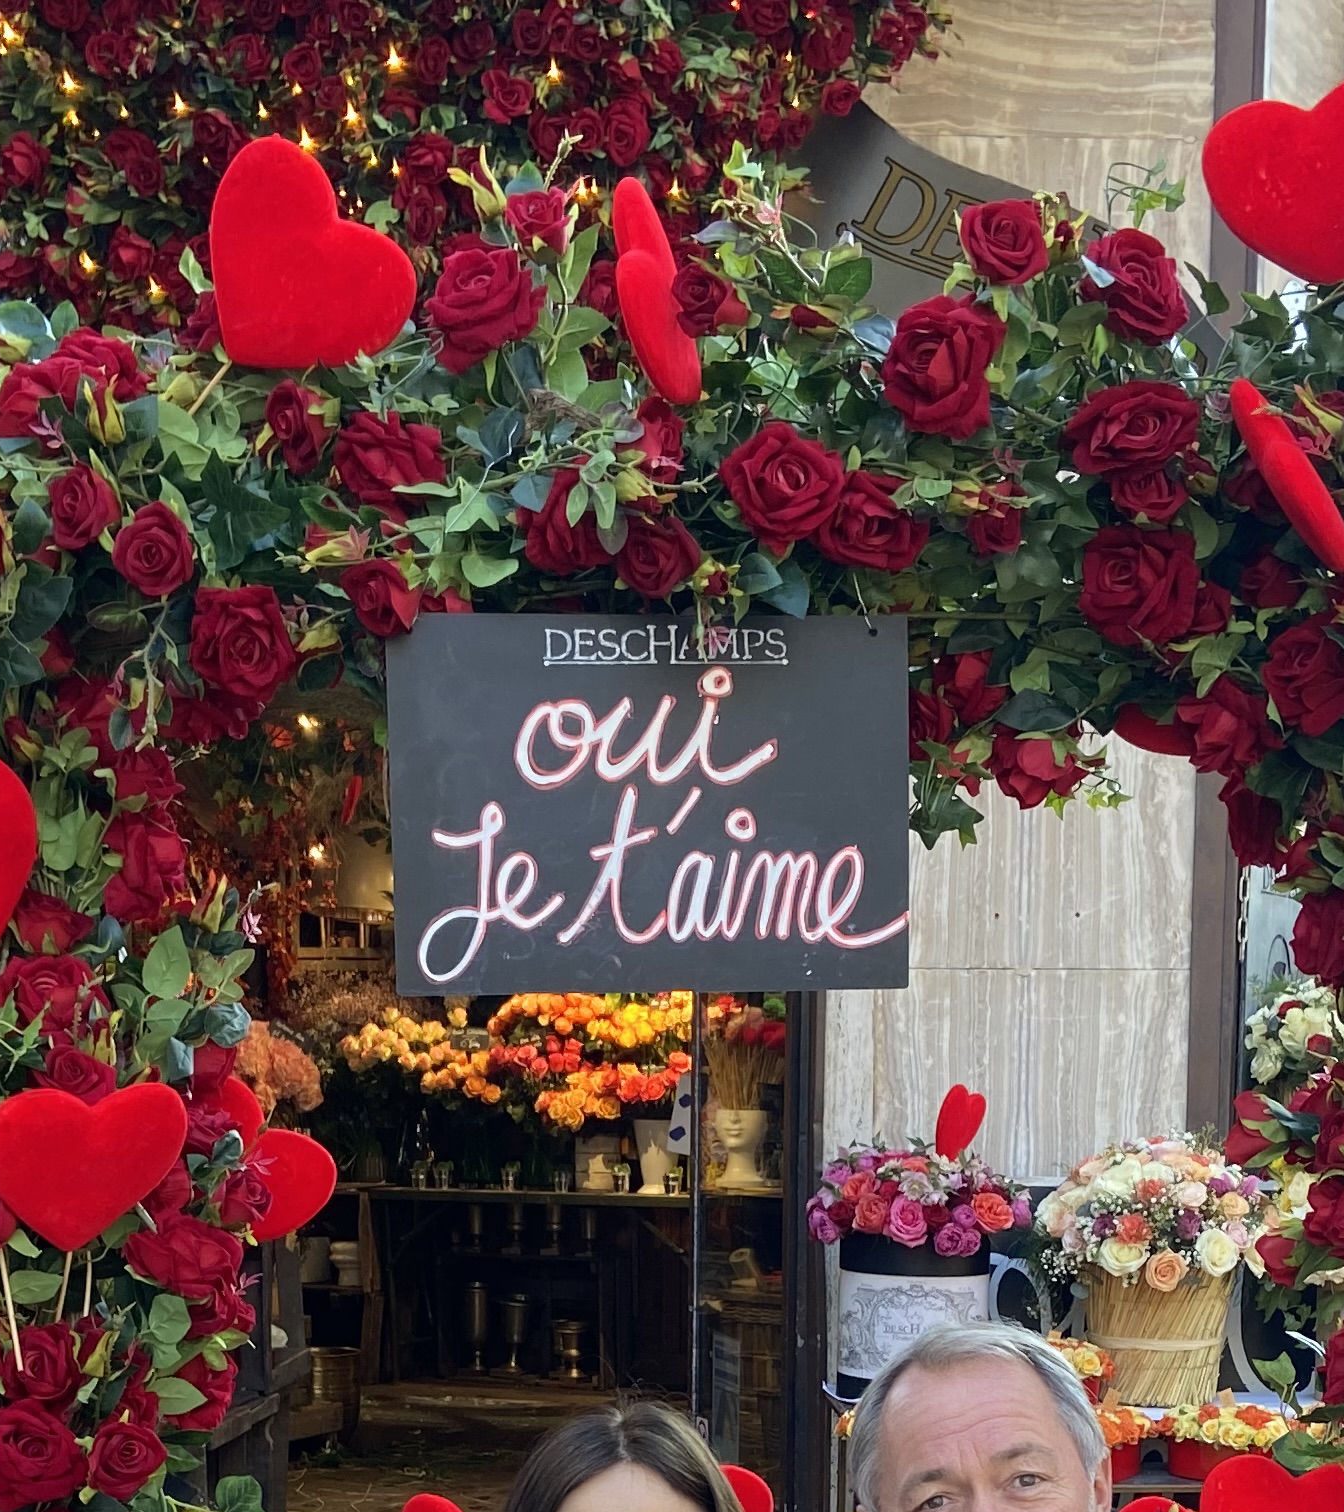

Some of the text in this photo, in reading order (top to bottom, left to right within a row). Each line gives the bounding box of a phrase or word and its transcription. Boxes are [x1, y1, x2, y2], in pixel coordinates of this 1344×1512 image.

[543, 624, 788, 664] DESCHAMPS
[514, 665, 779, 789] oui
[418, 784, 909, 984] Je t'aime
